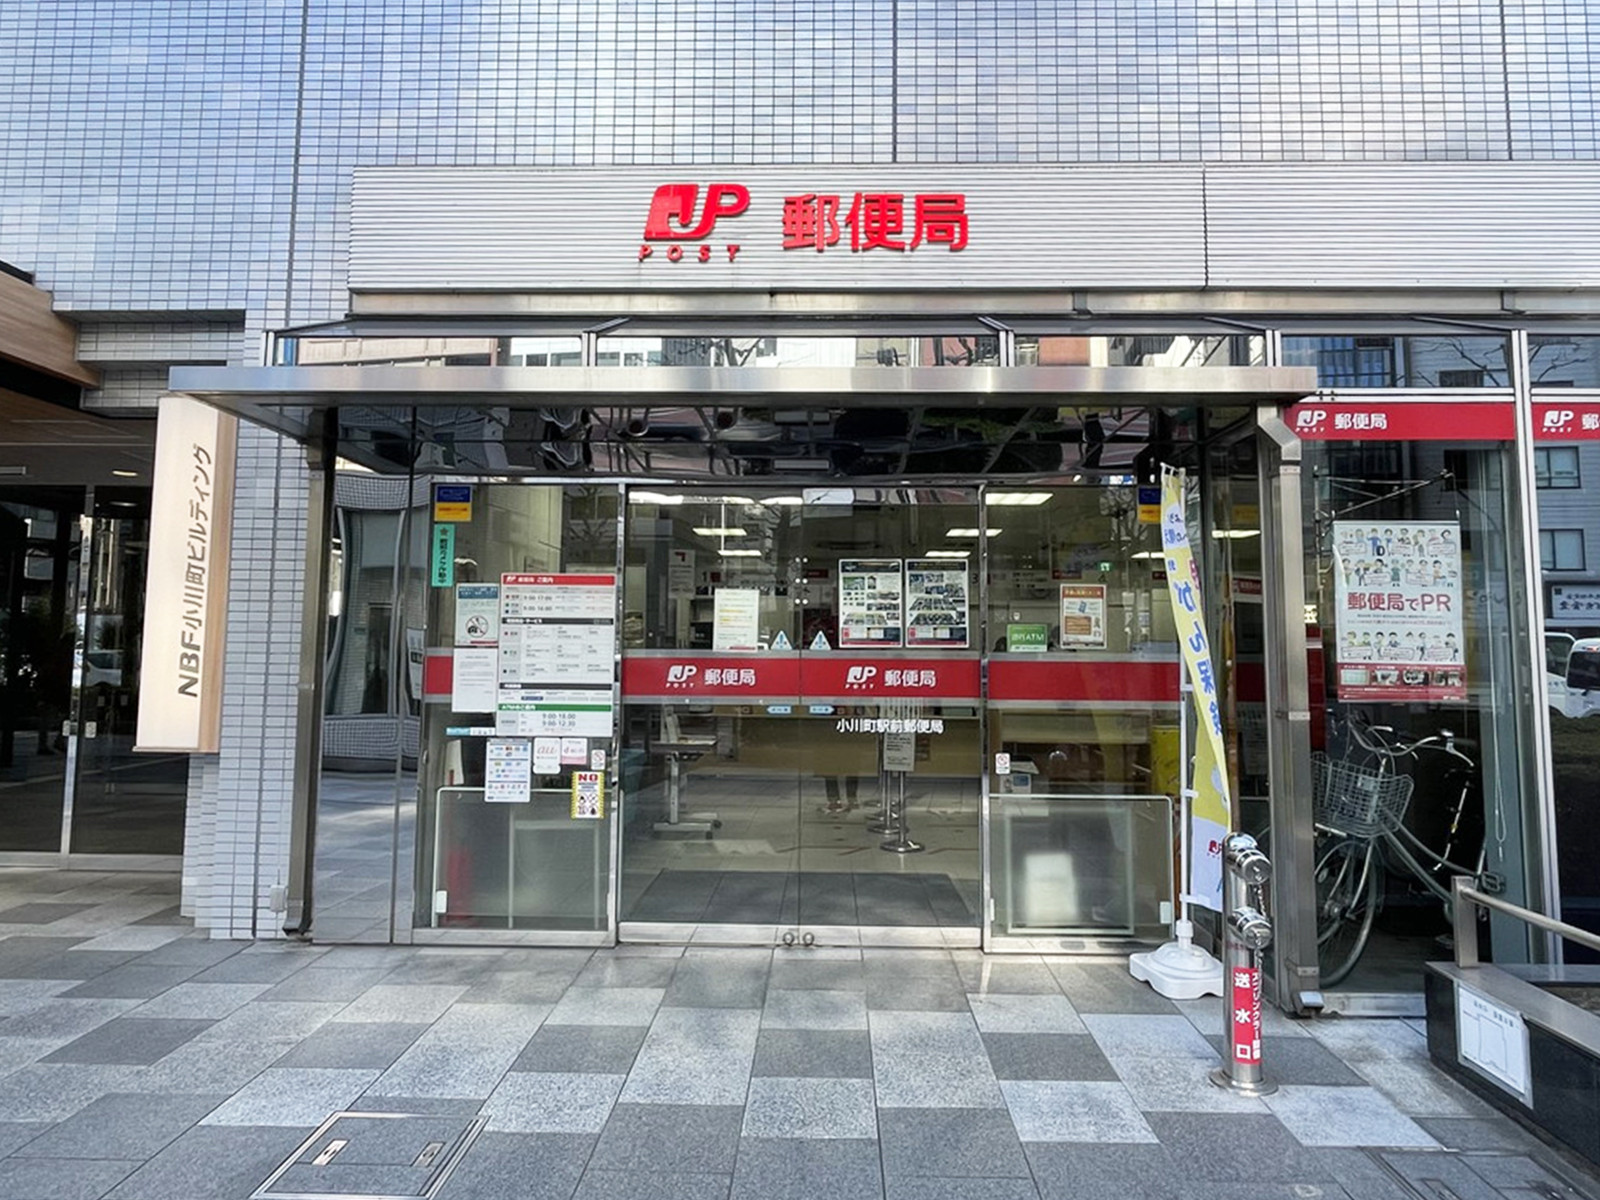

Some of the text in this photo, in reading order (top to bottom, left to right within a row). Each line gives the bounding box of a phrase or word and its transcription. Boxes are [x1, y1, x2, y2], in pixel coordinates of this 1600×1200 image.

[644, 183, 750, 241] JP
[782, 192, 968, 252] 郵便局
[639, 245, 740, 262] POST
[1297, 410, 1327, 427] JP
[1334, 413, 1387, 429] 郵便局
[1544, 410, 1574, 427] JP
[1582, 413, 1600, 430] 郵
[177, 444, 212, 697] NBF小川町ビルディング
[1347, 592, 1451, 611] 郵便局でPR
[667, 665, 697, 682] JP
[704, 669, 756, 686] 郵便局
[846, 666, 877, 683] JP
[884, 670, 936, 687] 郵便局
[836, 718, 944, 734] 小川町駅前郵便局
[578, 773, 598, 782] NO
[1234, 972, 1252, 1060] 送水口
